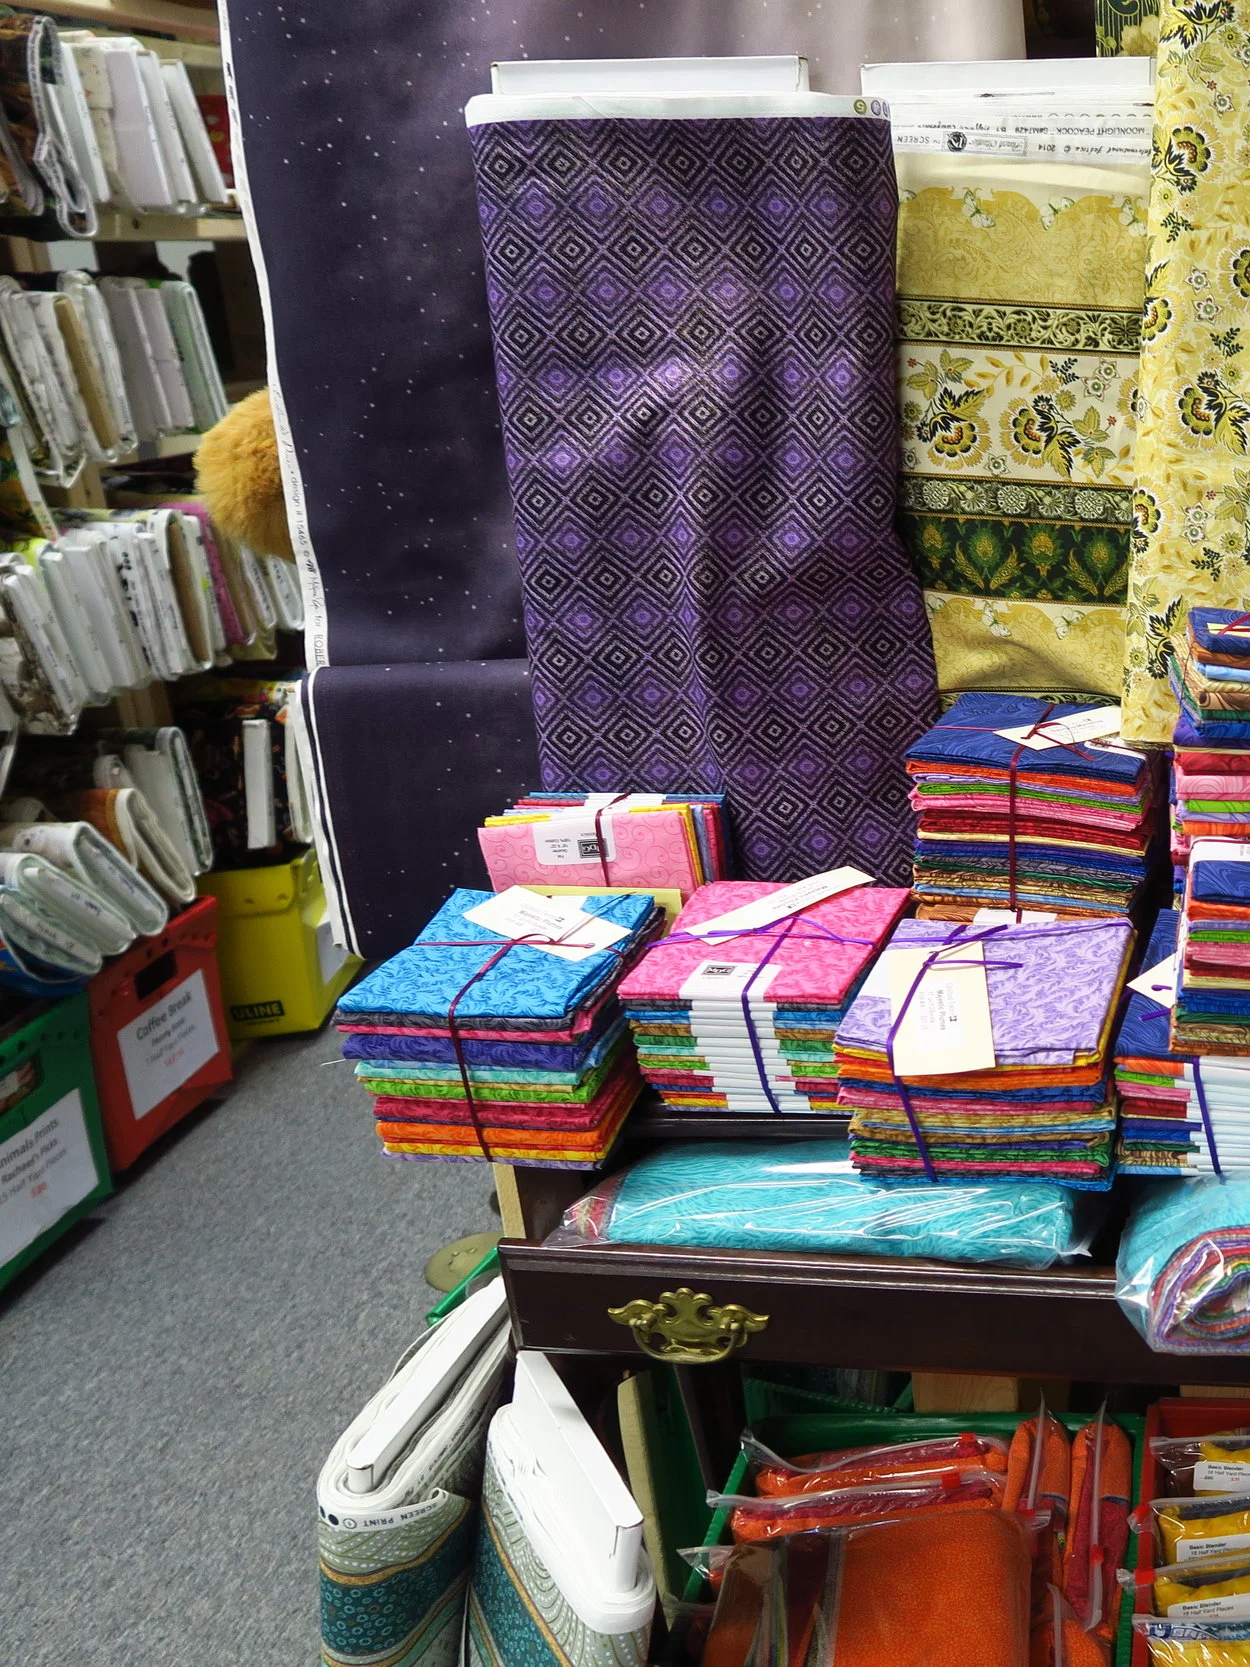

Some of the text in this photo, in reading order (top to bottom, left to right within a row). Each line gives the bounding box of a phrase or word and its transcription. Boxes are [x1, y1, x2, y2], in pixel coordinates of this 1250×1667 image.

[896, 135, 930, 144] SCREEN
[1038, 144, 1056, 152] 2014
[288, 476, 303, 508] design
[135, 988, 192, 1043] Coffee Break
[0, 1134, 33, 1170] nimals
[363, 1501, 441, 1528] SCREEN PRINT
